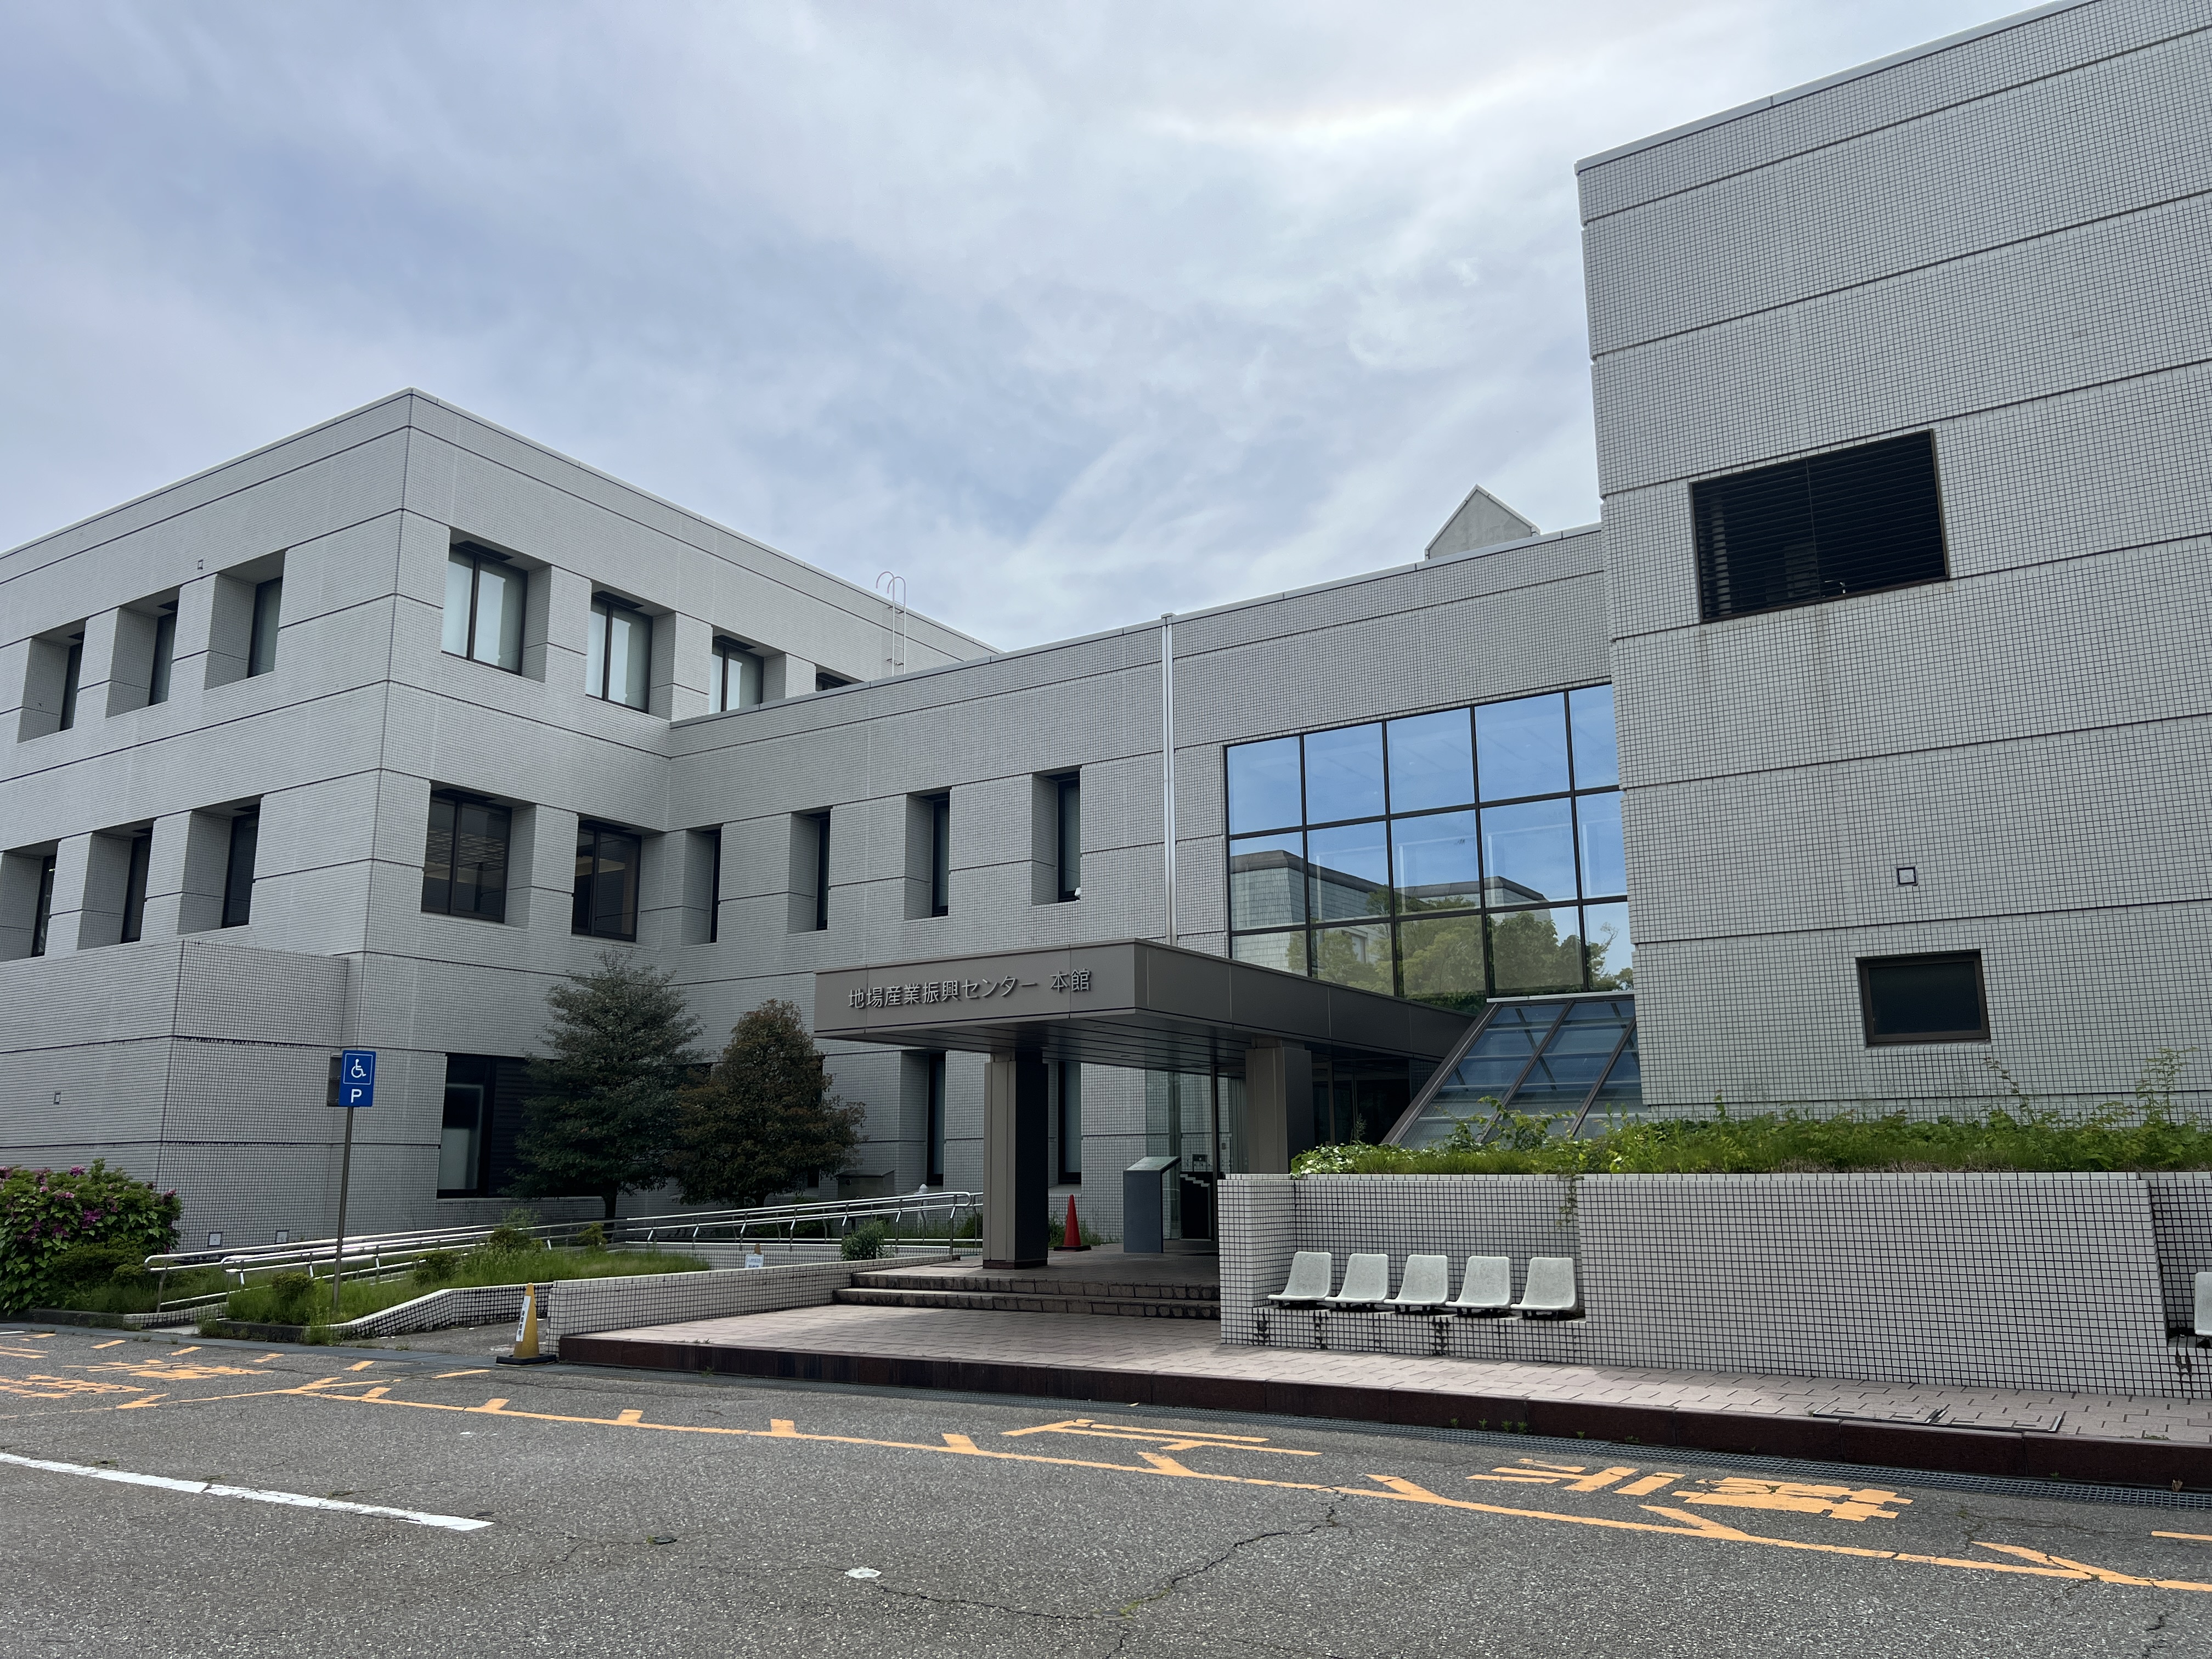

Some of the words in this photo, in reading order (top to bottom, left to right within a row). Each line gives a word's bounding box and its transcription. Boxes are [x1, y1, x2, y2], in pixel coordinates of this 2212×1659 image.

[848, 975, 1037, 1009] 地場産業振興センター
[1049, 968, 1091, 992] 本館
[351, 1088, 362, 1103] P
